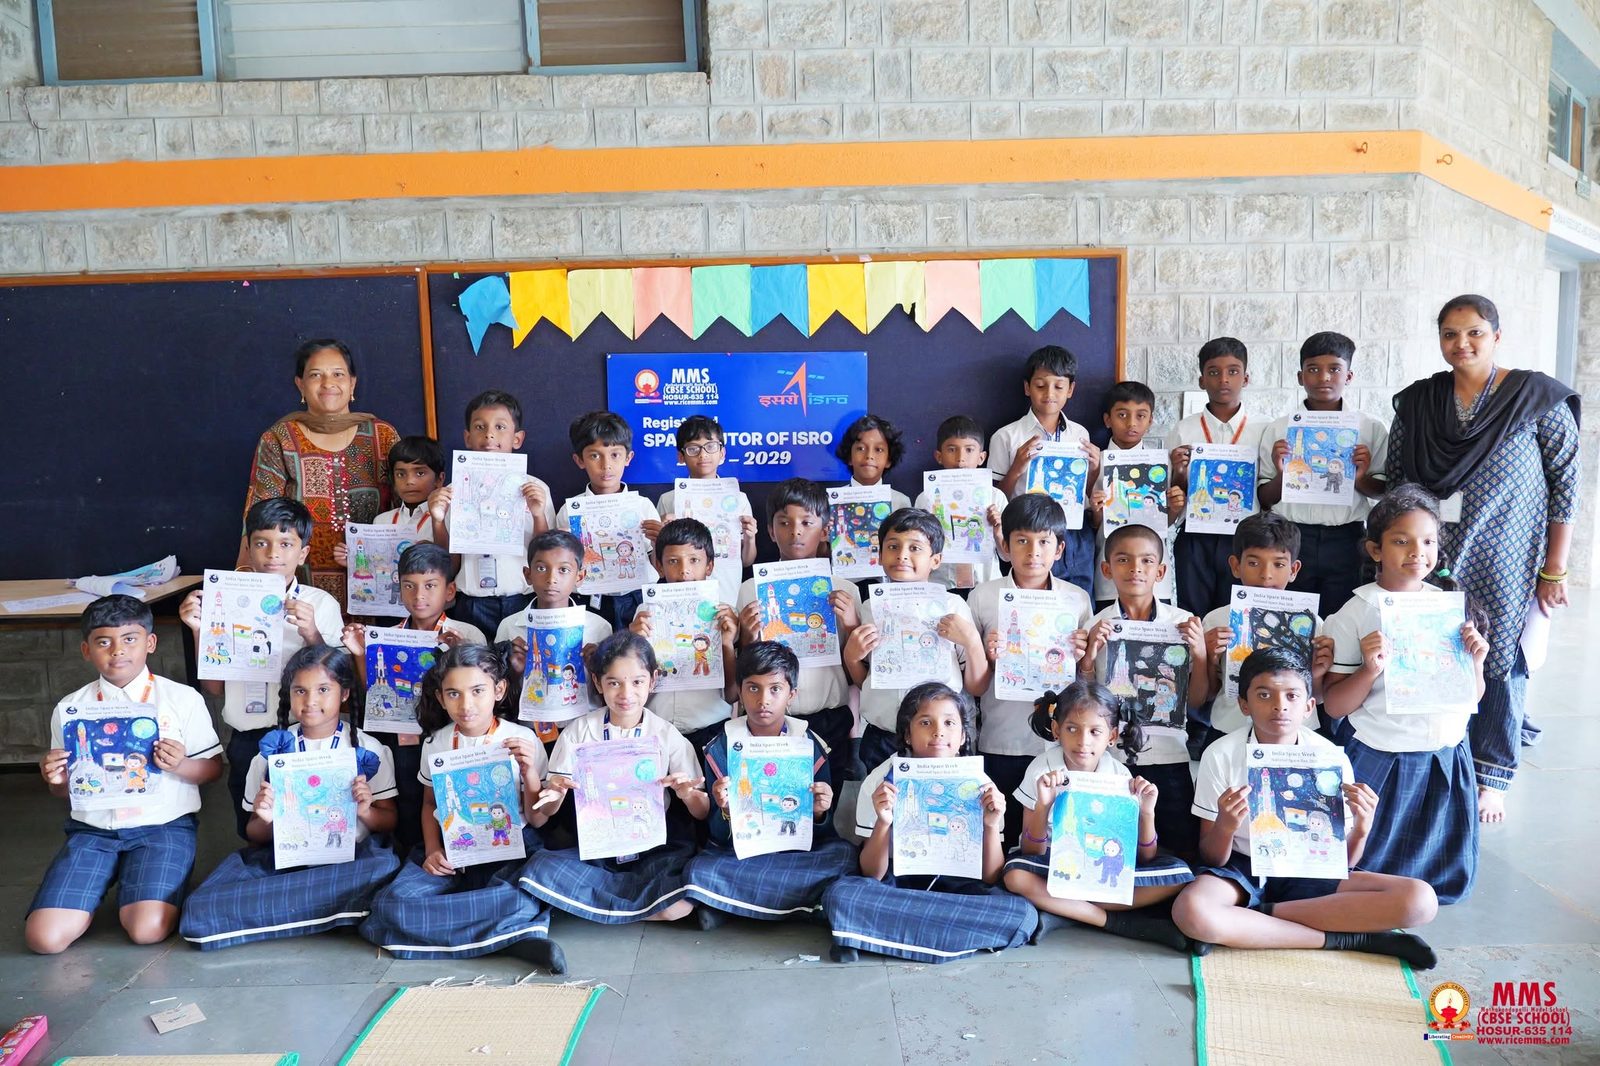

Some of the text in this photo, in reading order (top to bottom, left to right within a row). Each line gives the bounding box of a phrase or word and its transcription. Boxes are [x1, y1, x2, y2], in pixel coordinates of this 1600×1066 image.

[672, 368, 710, 383] MMS
[663, 385, 718, 395] (CBSE SCHOOL)
[758, 392, 799, 407] इसरो
[643, 433, 677, 447] SPA
[766, 432, 789, 446] OF
[792, 431, 833, 445] ISRO
[743, 451, 792, 465] 2029
